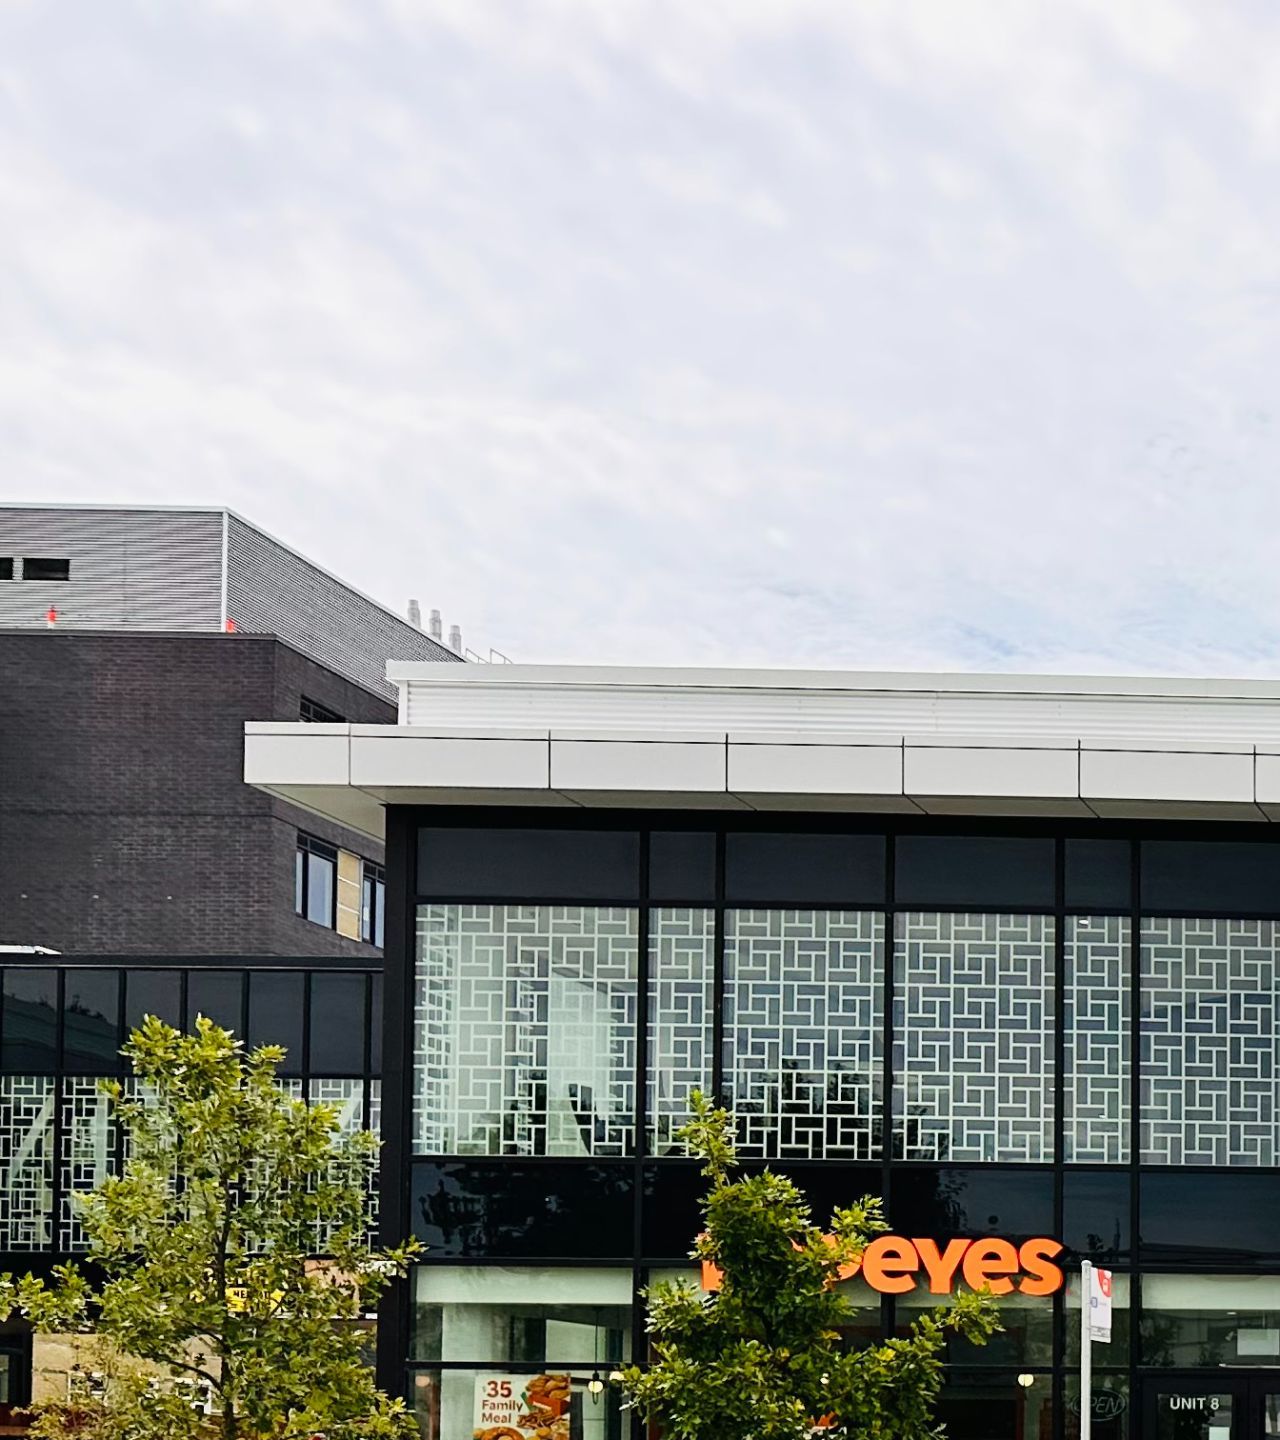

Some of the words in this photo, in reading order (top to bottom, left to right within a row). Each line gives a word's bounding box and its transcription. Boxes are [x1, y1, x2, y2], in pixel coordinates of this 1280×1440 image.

[482, 1400, 523, 1413] Family
[1170, 1397, 1207, 1410] UNIT
[1210, 1397, 1220, 1410] 8
[482, 1413, 512, 1424] Meal
